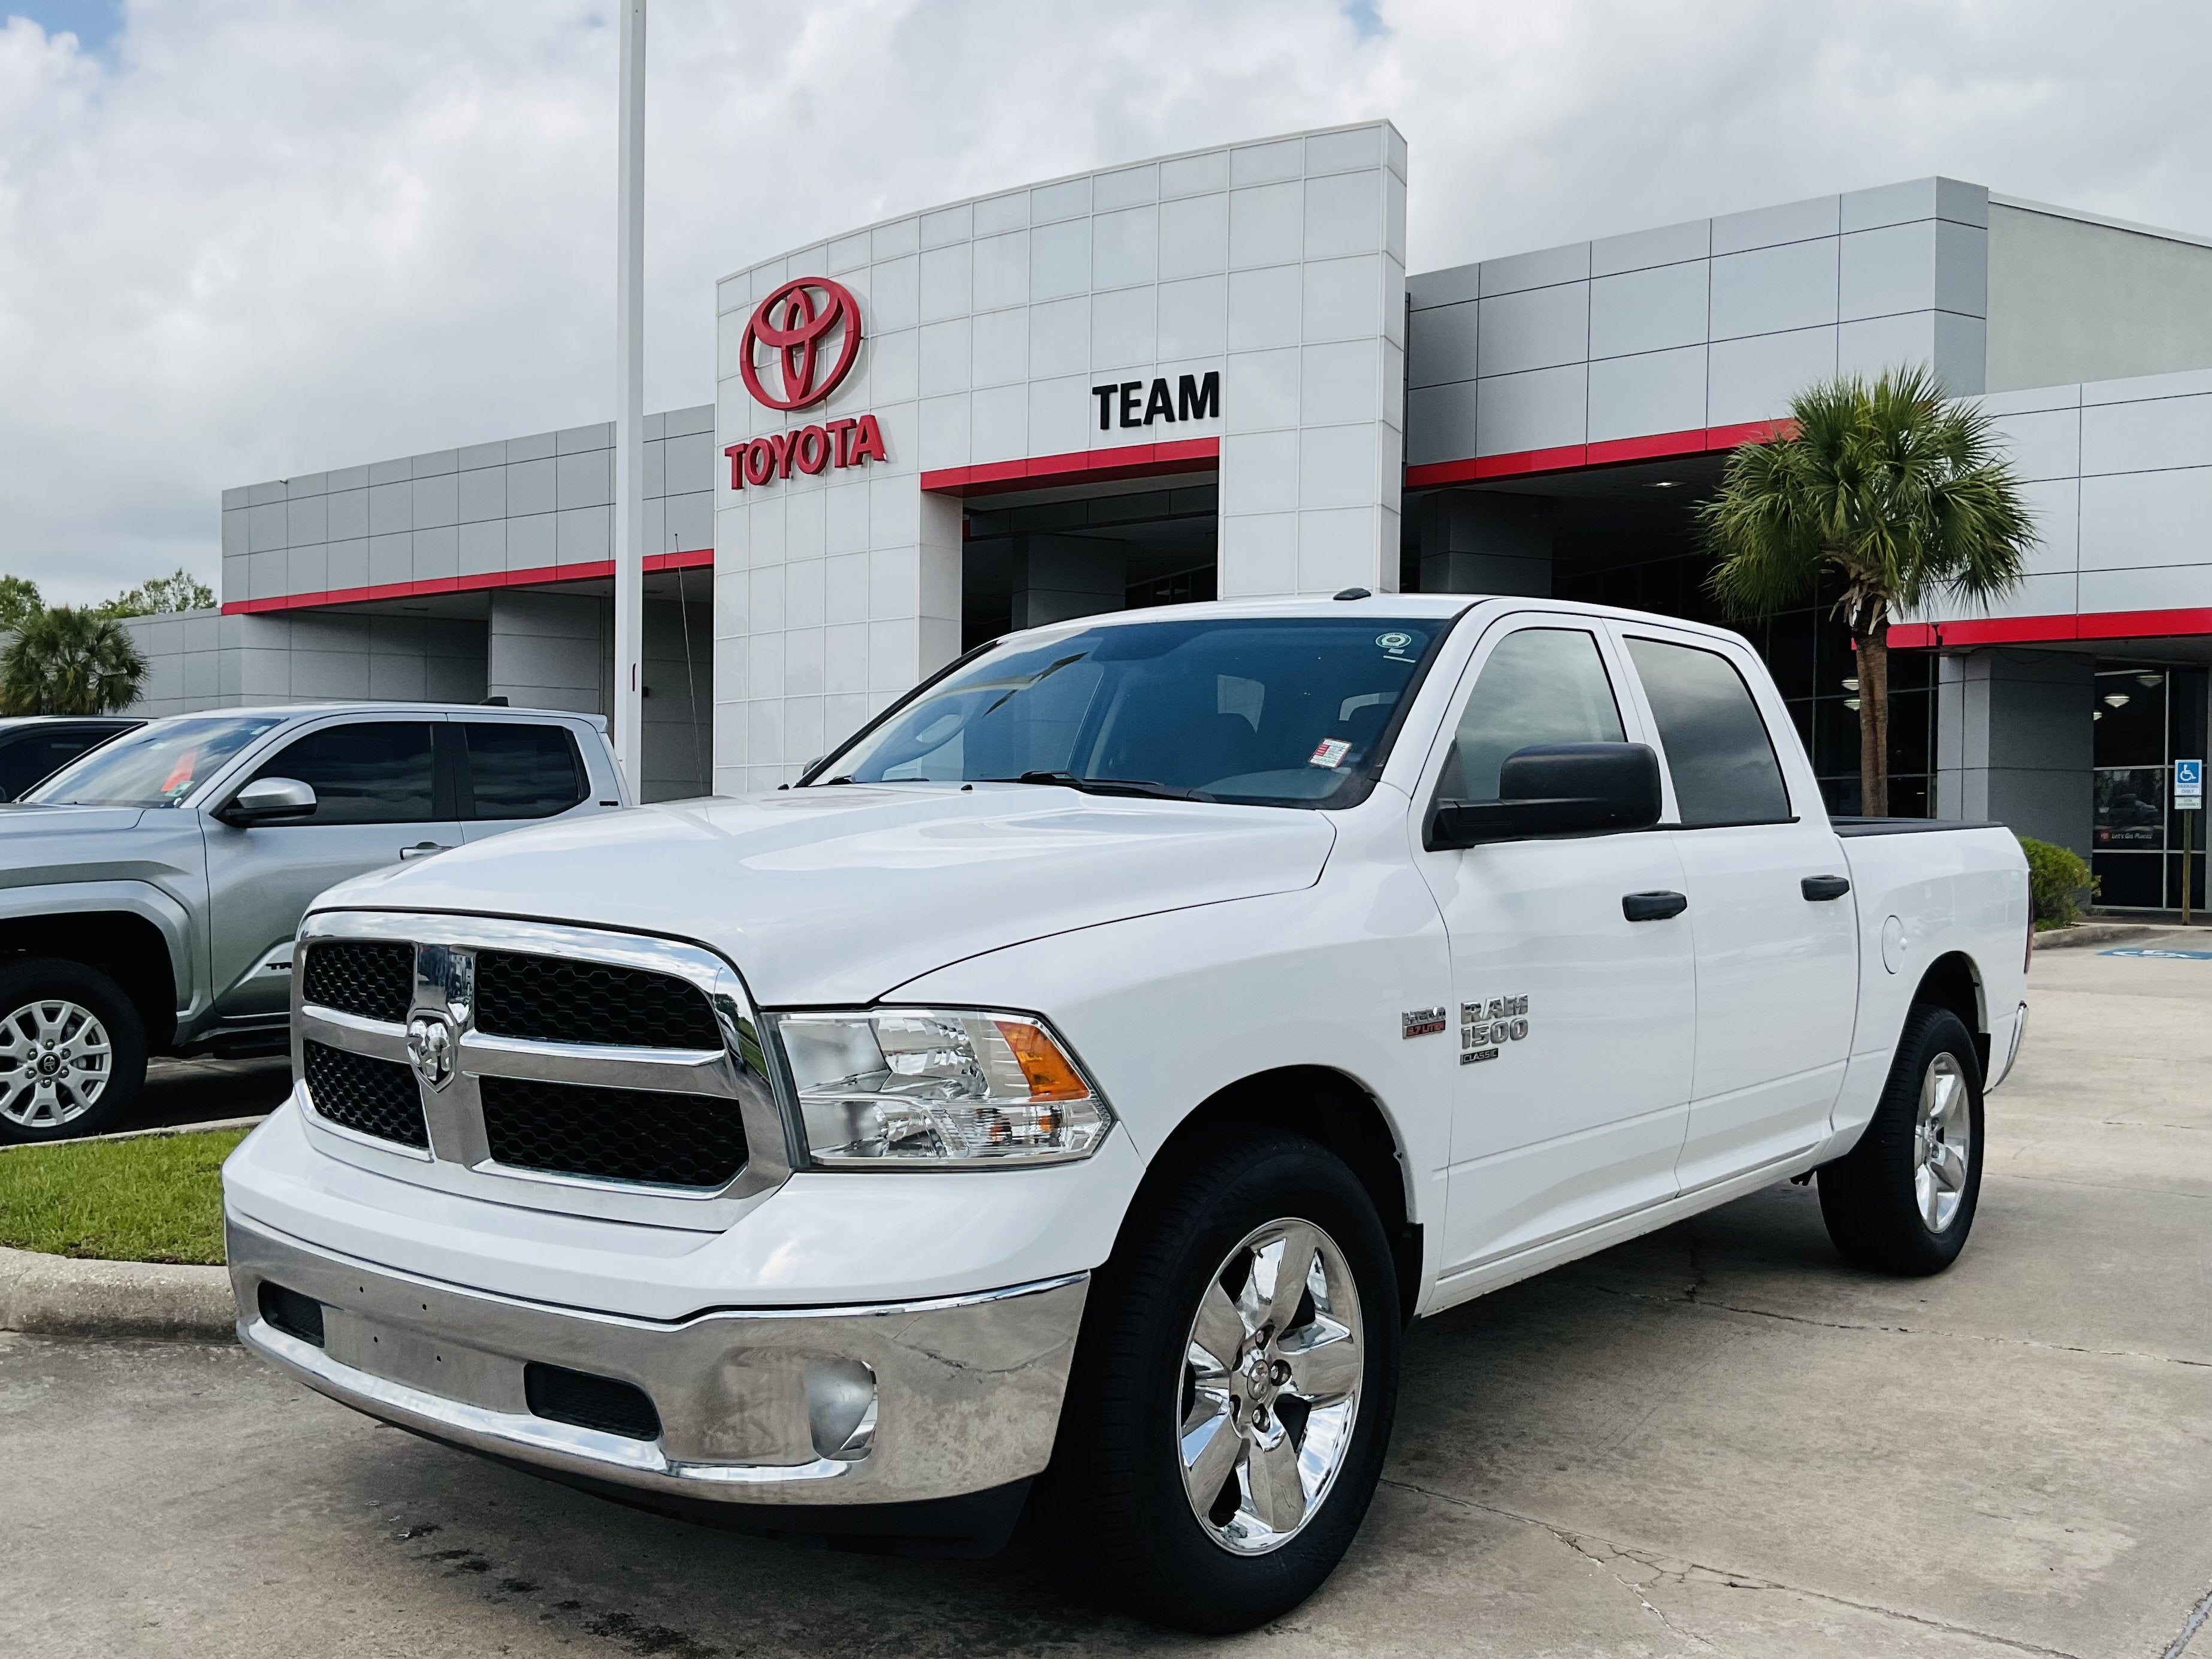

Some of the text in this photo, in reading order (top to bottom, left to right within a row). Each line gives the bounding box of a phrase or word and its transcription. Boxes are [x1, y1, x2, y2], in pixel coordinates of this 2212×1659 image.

[1092, 371, 1219, 430] TEAM
[724, 414, 887, 490] TOYOTA
[1461, 994, 1528, 1025] RAM
[1461, 1018, 1528, 1049] 1500
[1463, 1048, 1498, 1062] CLASSIC
